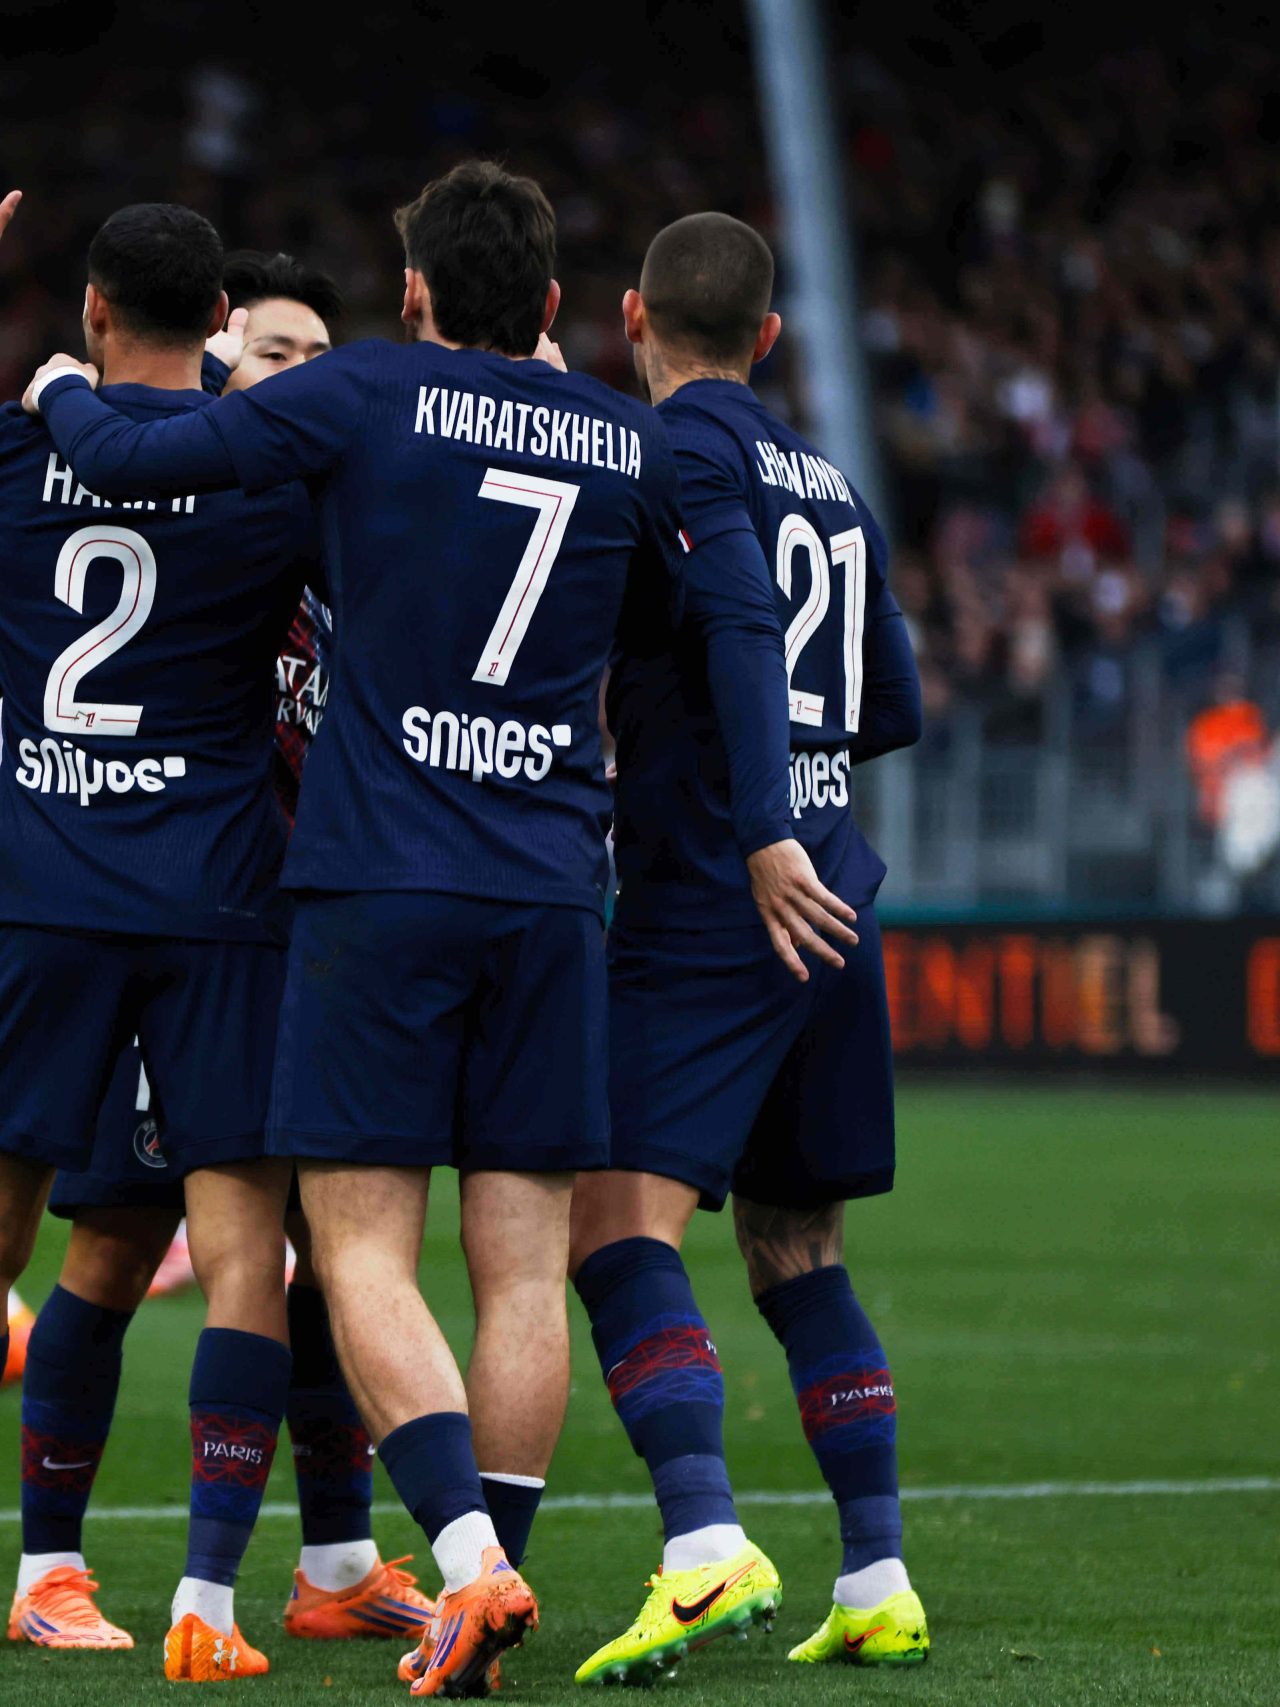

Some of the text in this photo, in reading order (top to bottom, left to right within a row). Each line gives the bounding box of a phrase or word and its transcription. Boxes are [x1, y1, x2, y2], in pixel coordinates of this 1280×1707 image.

[414, 385, 641, 479] KVARATSKHELIA
[472, 468, 581, 686] 7
[776, 513, 867, 733] 21
[43, 525, 157, 737] 2
[402, 706, 555, 782] snipes
[831, 1384, 894, 1406] PARIS
[204, 1441, 264, 1464] PARIS
